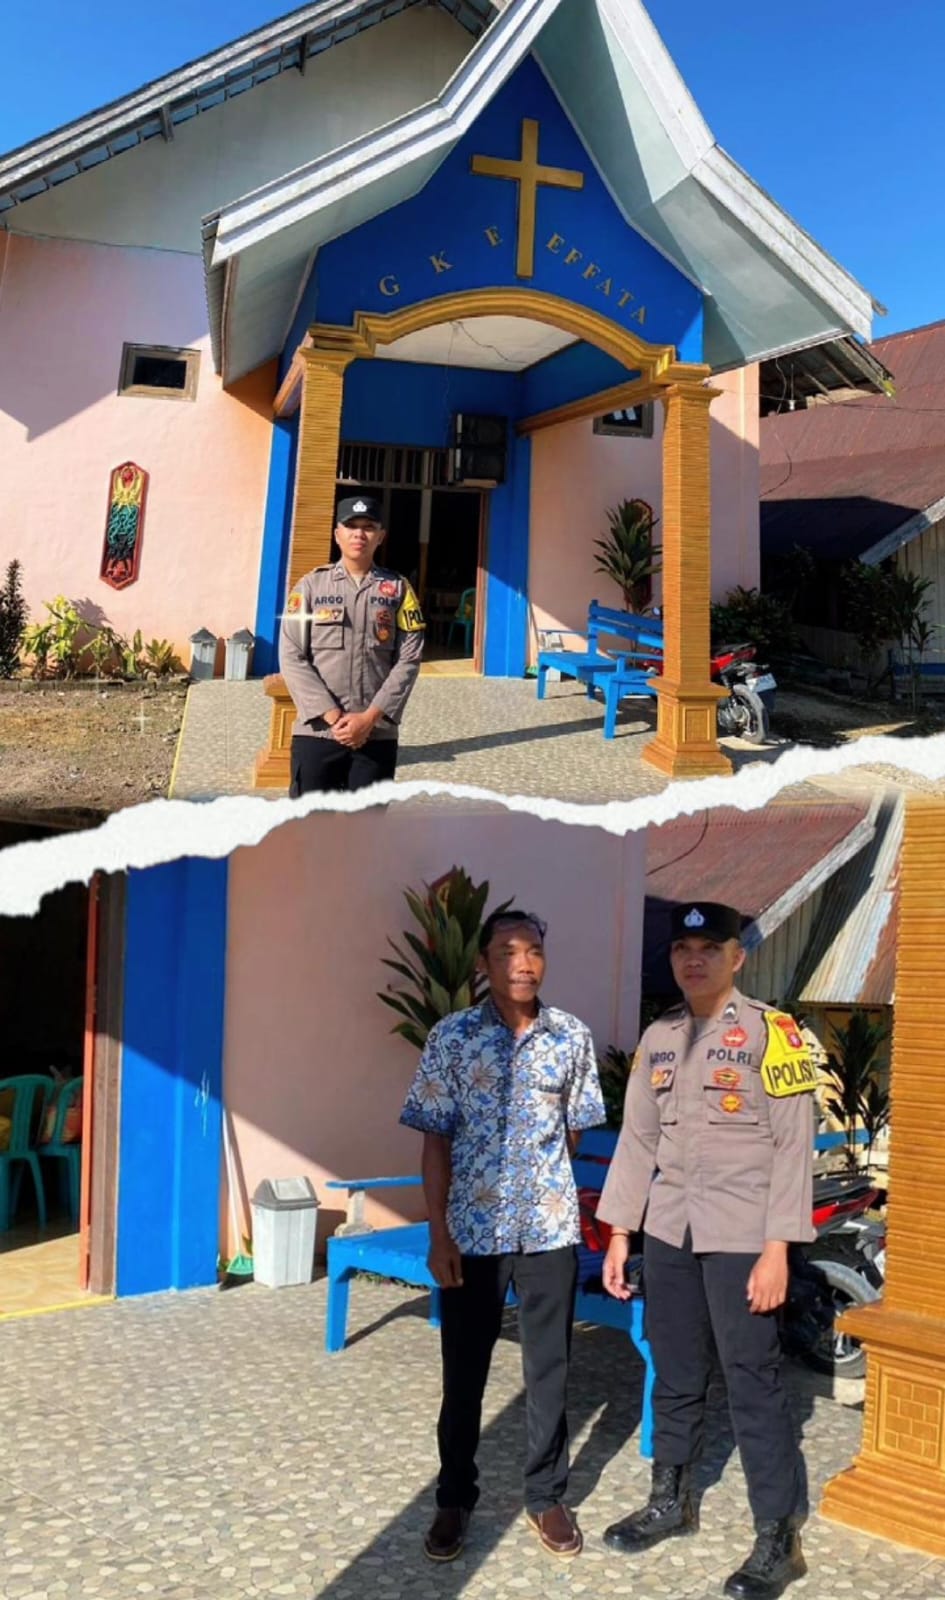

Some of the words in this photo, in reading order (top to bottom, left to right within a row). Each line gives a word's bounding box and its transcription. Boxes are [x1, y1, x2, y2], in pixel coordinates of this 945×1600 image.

[546, 233, 647, 324] EFFATA
[314, 596, 343, 605] ARGO
[706, 1049, 752, 1065] POLRI
